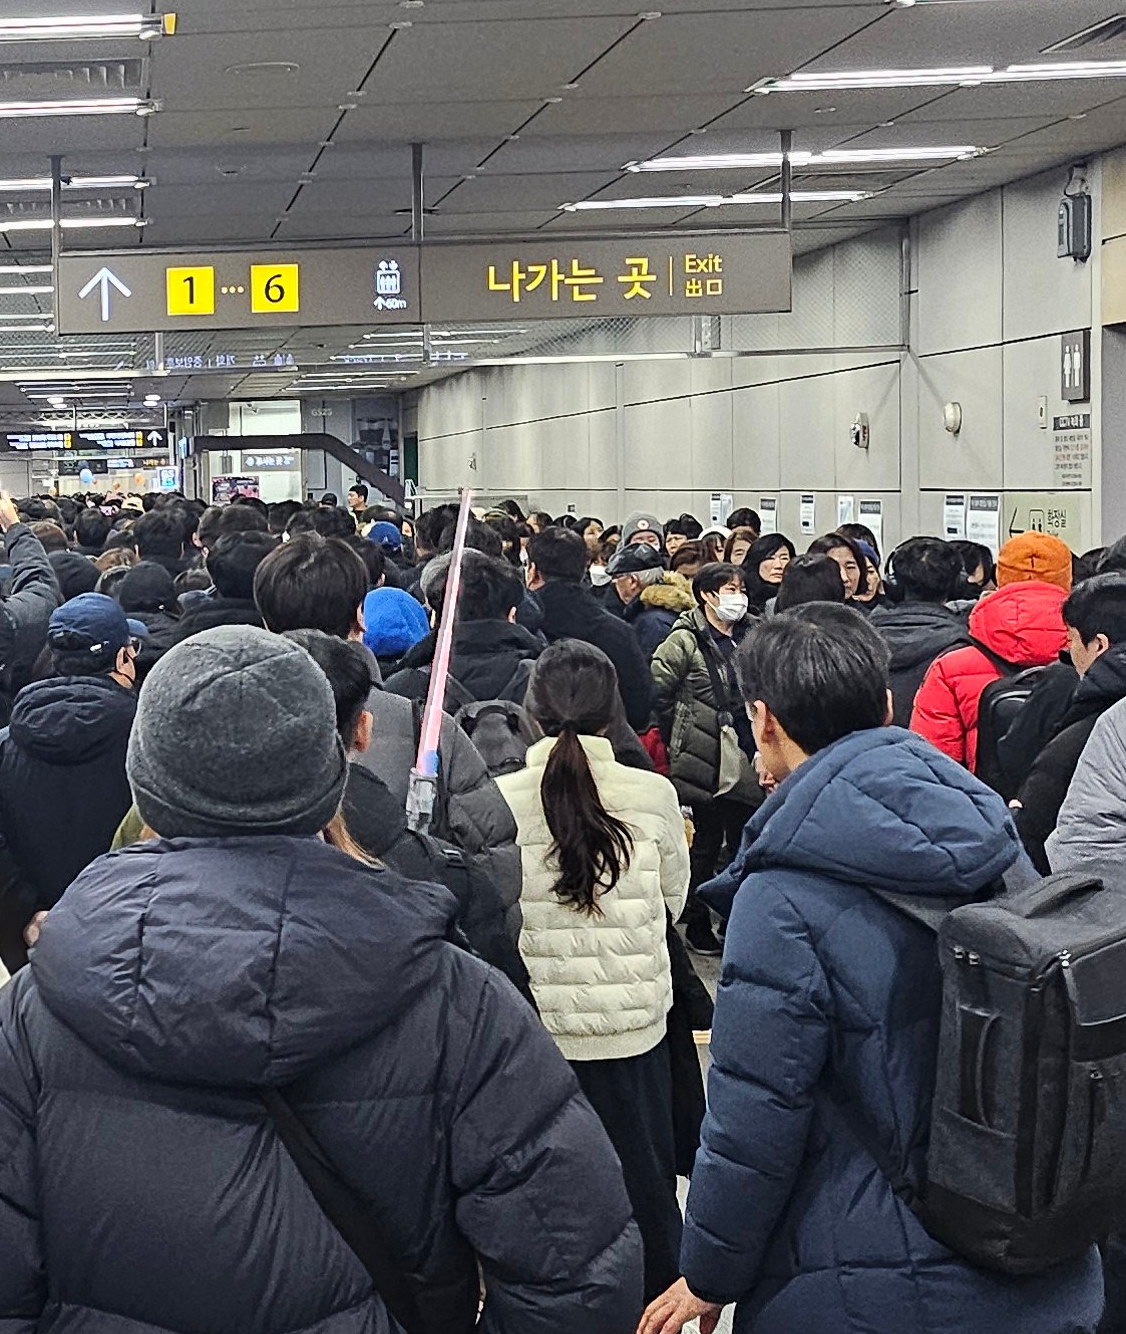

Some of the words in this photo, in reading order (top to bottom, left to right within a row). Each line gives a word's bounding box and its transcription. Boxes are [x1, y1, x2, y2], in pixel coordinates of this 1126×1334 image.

[685, 253, 723, 274] Exit
[183, 276, 195, 305] 1
[264, 274, 285, 303] 6
[487, 258, 604, 303] 나가는
[617, 256, 657, 300] 곳
[685, 278, 723, 298] 出口
[311, 407, 333, 417] GS25
